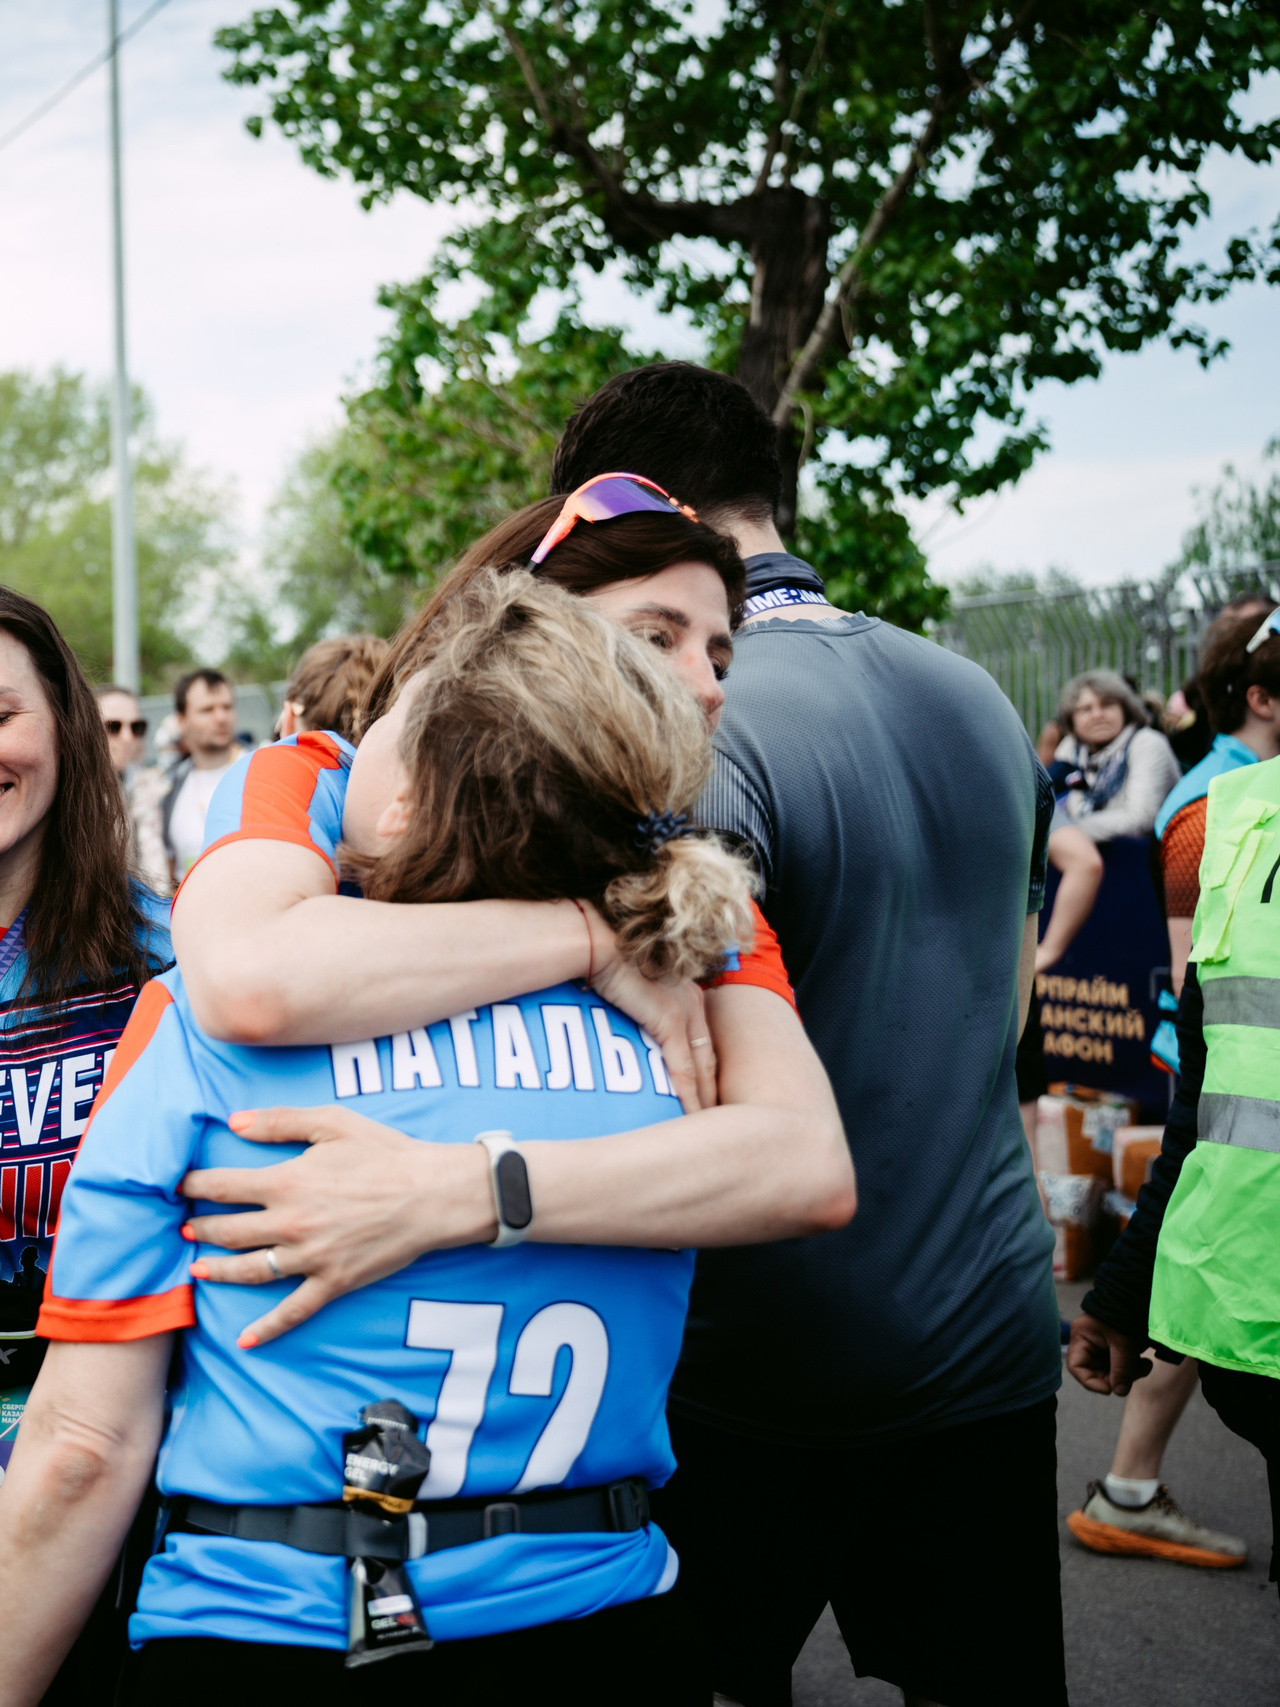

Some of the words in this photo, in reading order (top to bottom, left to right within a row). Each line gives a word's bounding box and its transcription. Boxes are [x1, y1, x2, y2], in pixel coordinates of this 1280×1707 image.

[405, 1299, 610, 1500] 72
[344, 1466, 367, 1483] GEL
[346, 1453, 399, 1477] ENERGY
